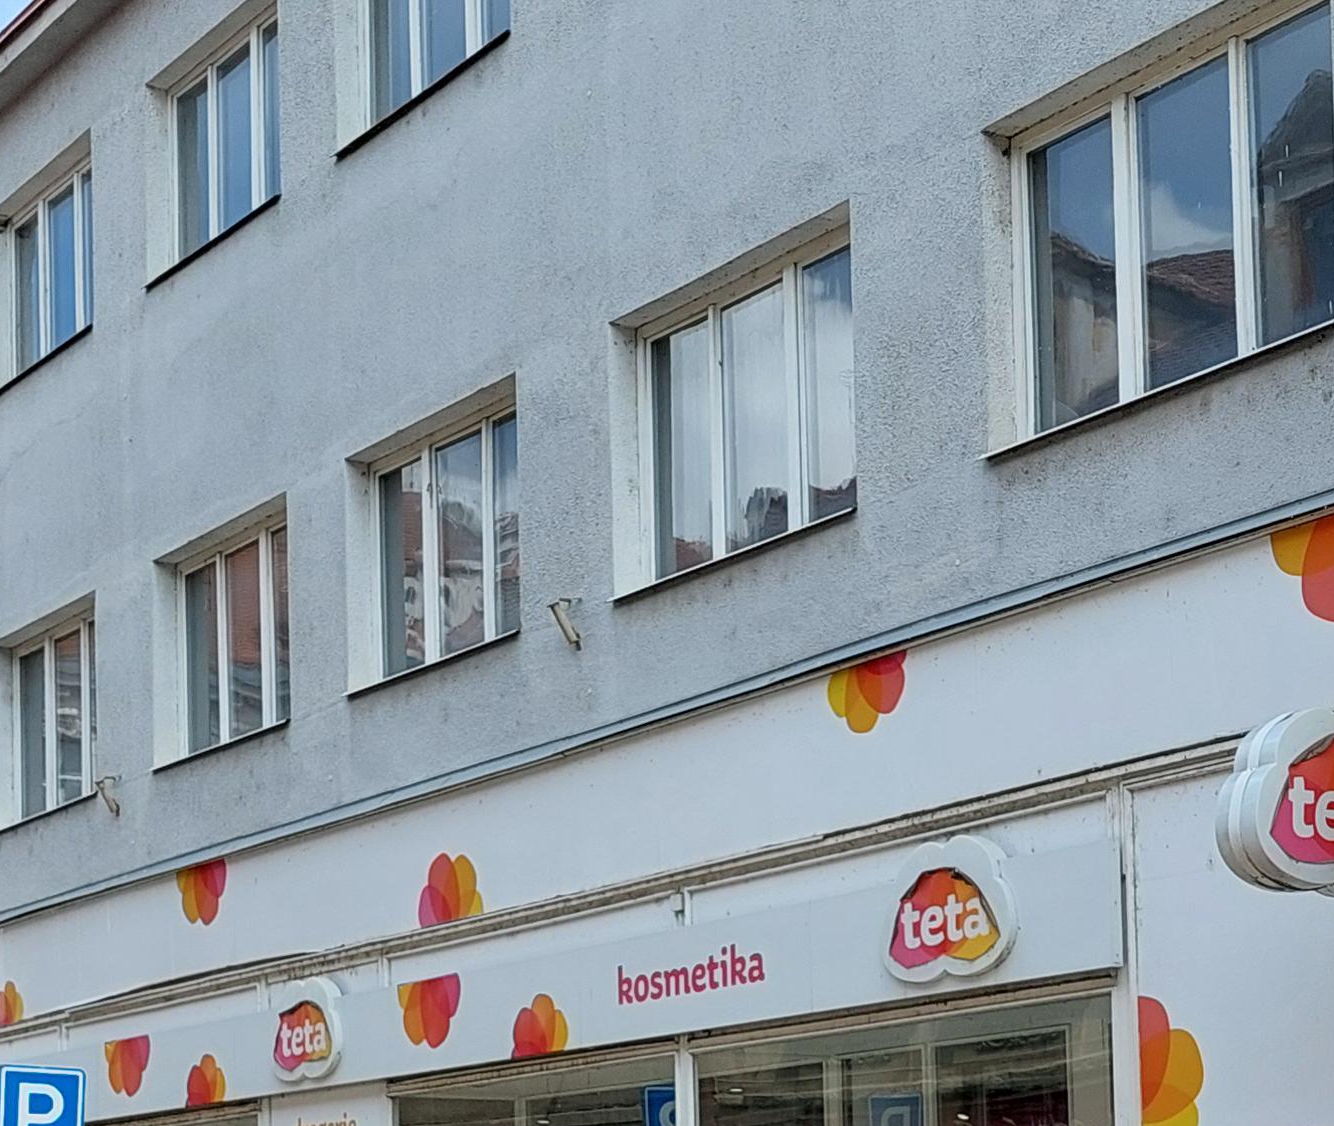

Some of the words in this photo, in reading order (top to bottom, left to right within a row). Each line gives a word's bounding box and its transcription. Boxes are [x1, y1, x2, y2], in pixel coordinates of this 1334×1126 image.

[900, 893, 990, 949] teta
[617, 945, 766, 1005] kosmetika
[280, 1018, 328, 1058] teta
